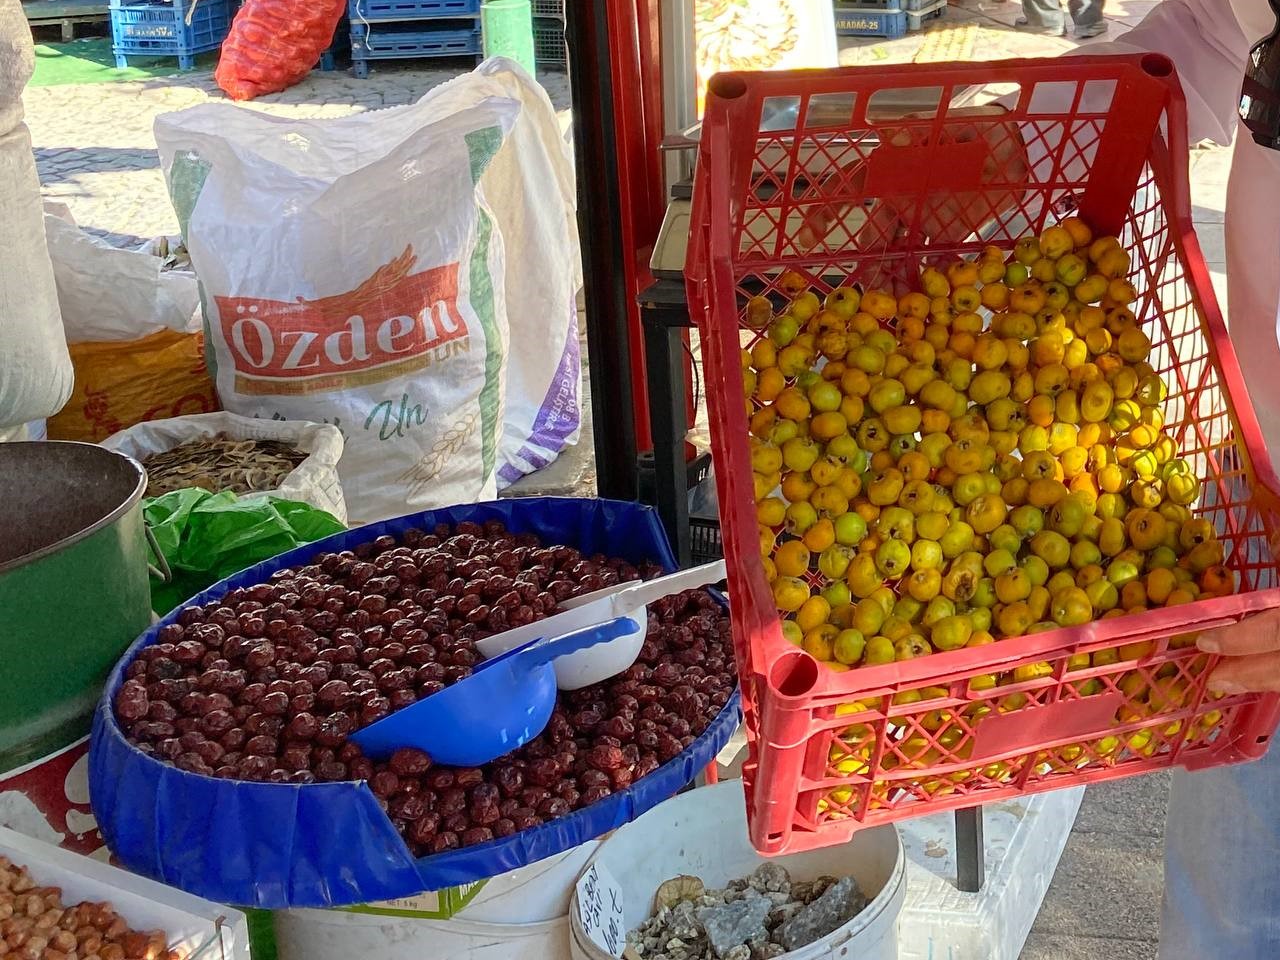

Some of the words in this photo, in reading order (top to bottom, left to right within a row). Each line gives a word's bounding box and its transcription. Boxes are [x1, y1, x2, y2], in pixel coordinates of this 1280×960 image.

[836, 19, 879, 31] ARADAĞ-25
[231, 298, 460, 370] Özden
[434, 337, 471, 363] UN
[363, 393, 429, 441] Un
